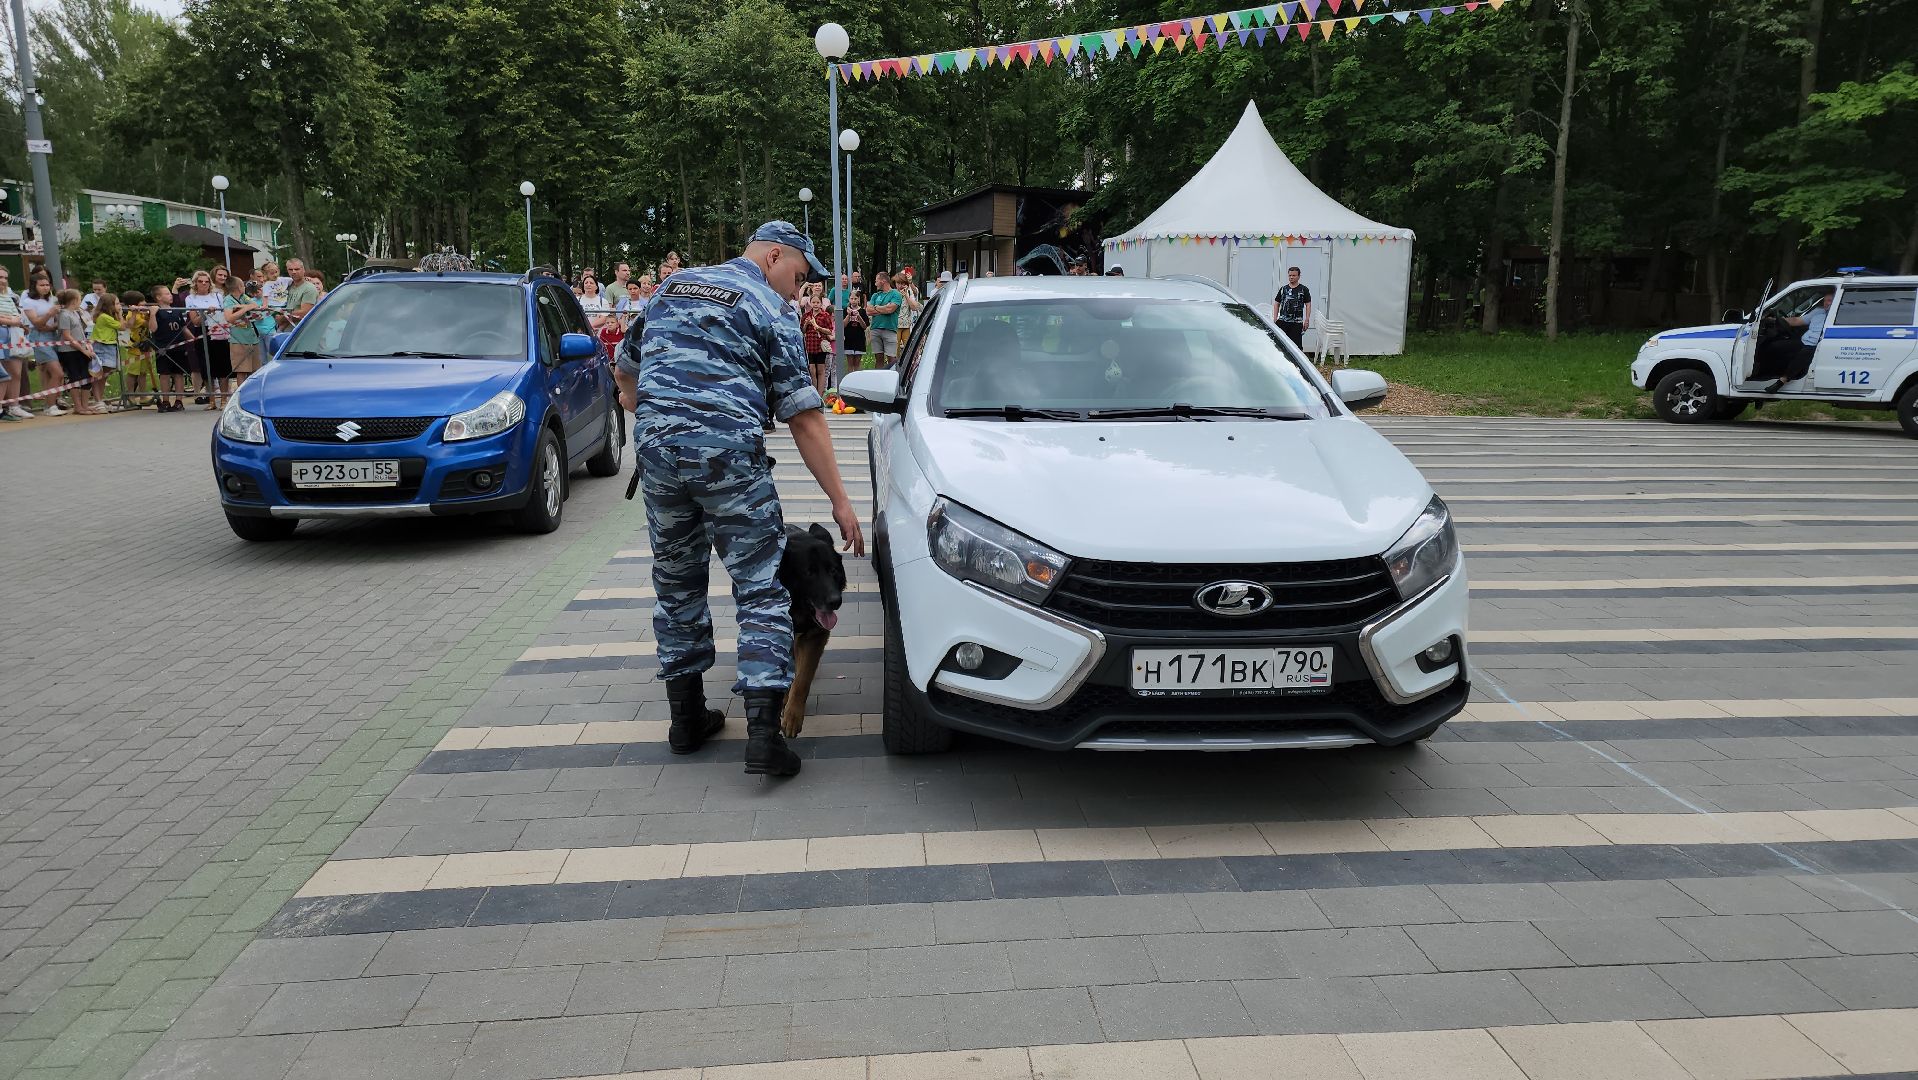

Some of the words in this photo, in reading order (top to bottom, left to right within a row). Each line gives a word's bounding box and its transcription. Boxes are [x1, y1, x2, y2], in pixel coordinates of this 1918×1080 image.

[672, 284, 732, 300] ПОЛИЦИЯ
[168, 321, 180, 331] 10
[1838, 370, 1870, 384] 112
[375, 463, 393, 474] 55
[1277, 650, 1324, 673] 790
[1286, 674, 1310, 683] RUS
